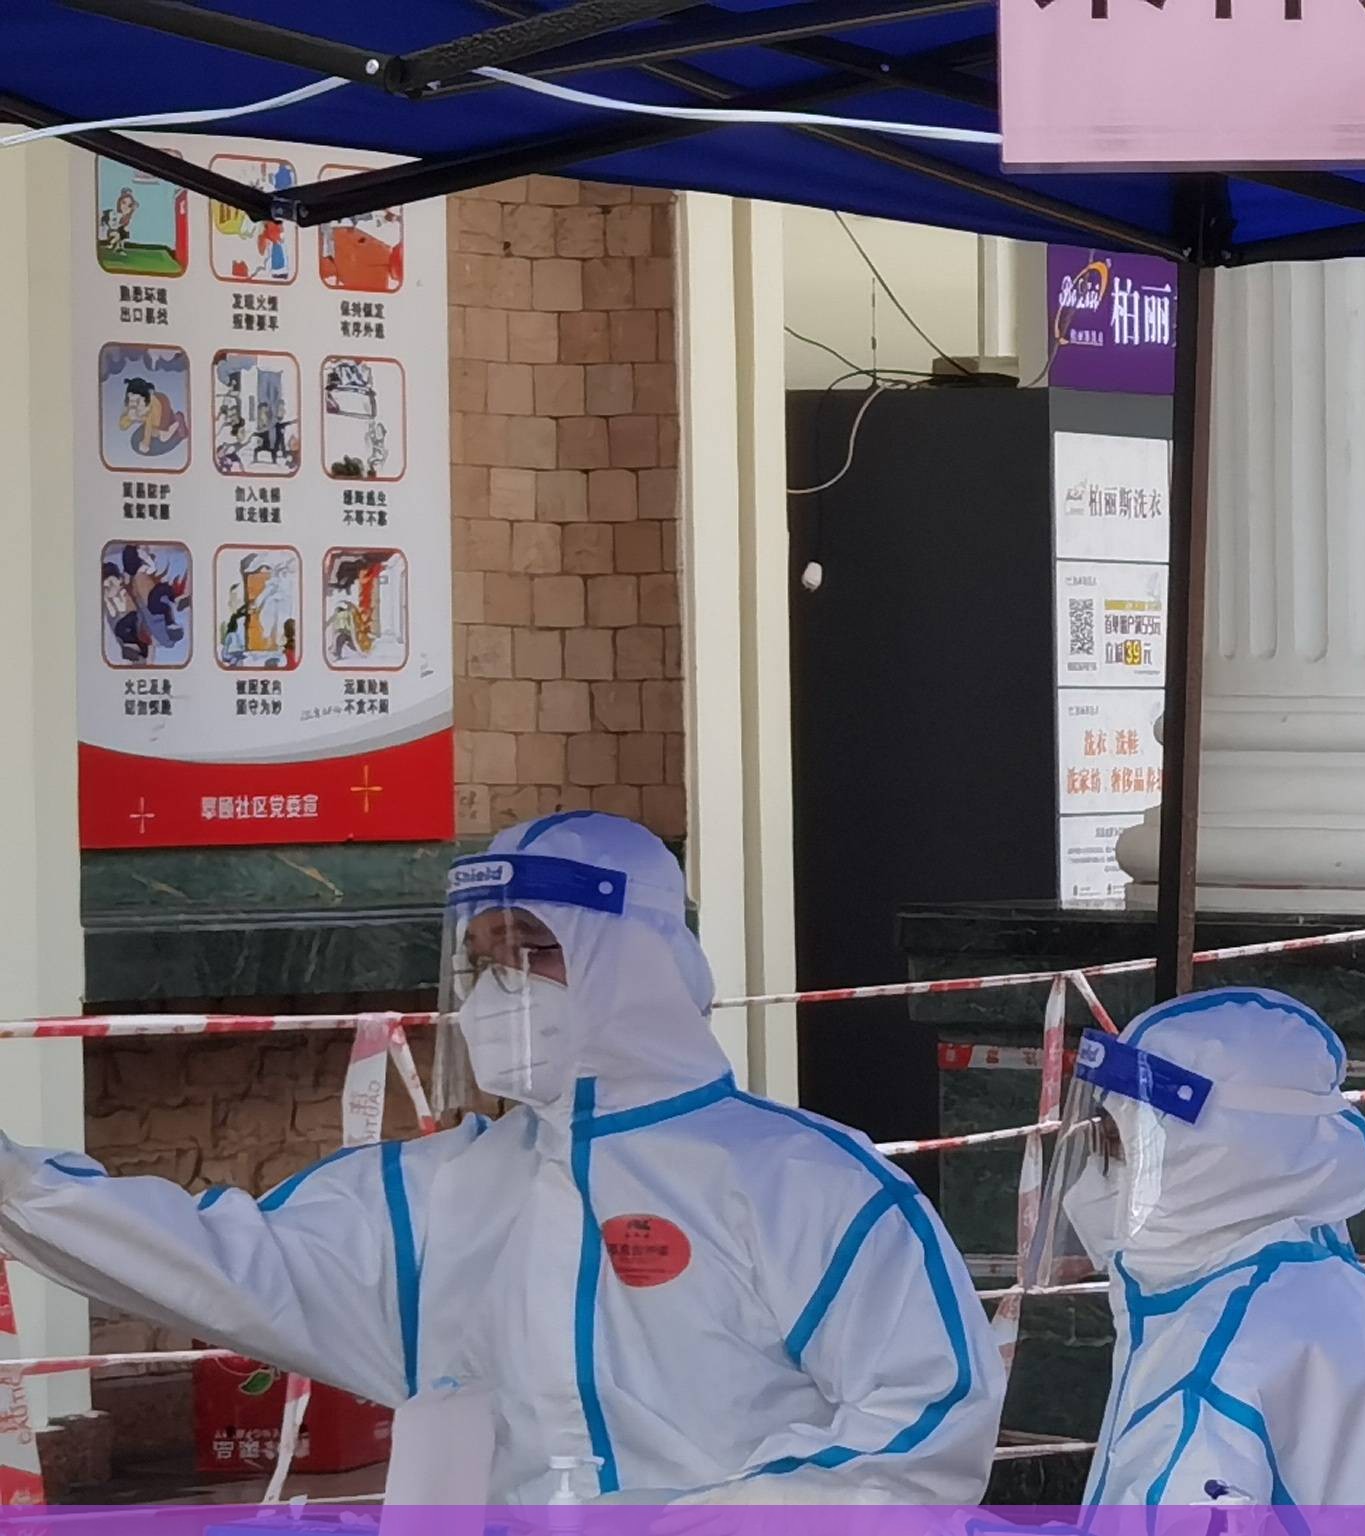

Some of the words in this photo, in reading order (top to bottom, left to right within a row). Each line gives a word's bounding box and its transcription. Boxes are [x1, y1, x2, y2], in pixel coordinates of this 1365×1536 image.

[1110, 276, 1178, 347] 柏丽
[1089, 483, 1162, 519] 柏丽斯洗衣
